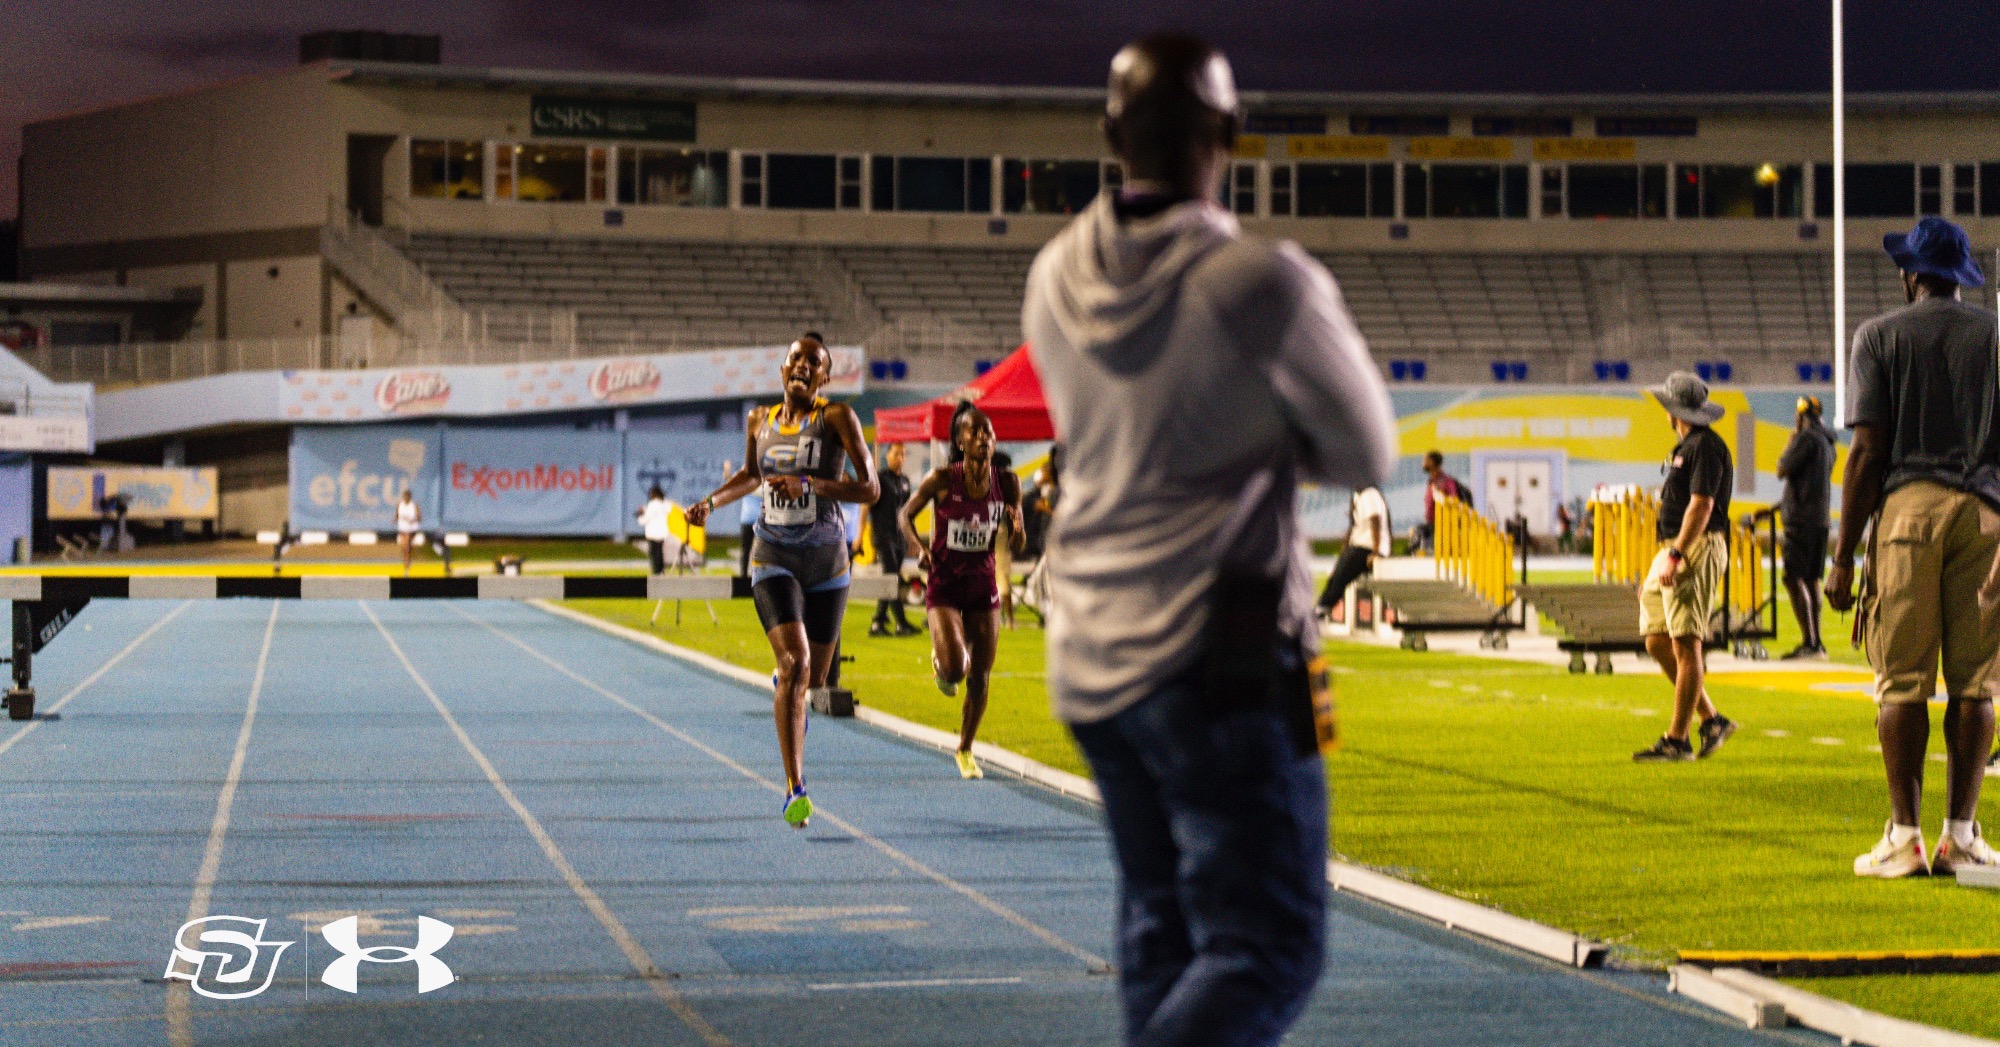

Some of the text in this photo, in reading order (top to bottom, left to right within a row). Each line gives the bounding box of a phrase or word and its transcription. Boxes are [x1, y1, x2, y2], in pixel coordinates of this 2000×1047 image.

[804, 440, 815, 467] 1
[309, 459, 409, 507] efcu
[451, 462, 614, 499] ExxonMobil
[952, 529, 987, 546] 1455
